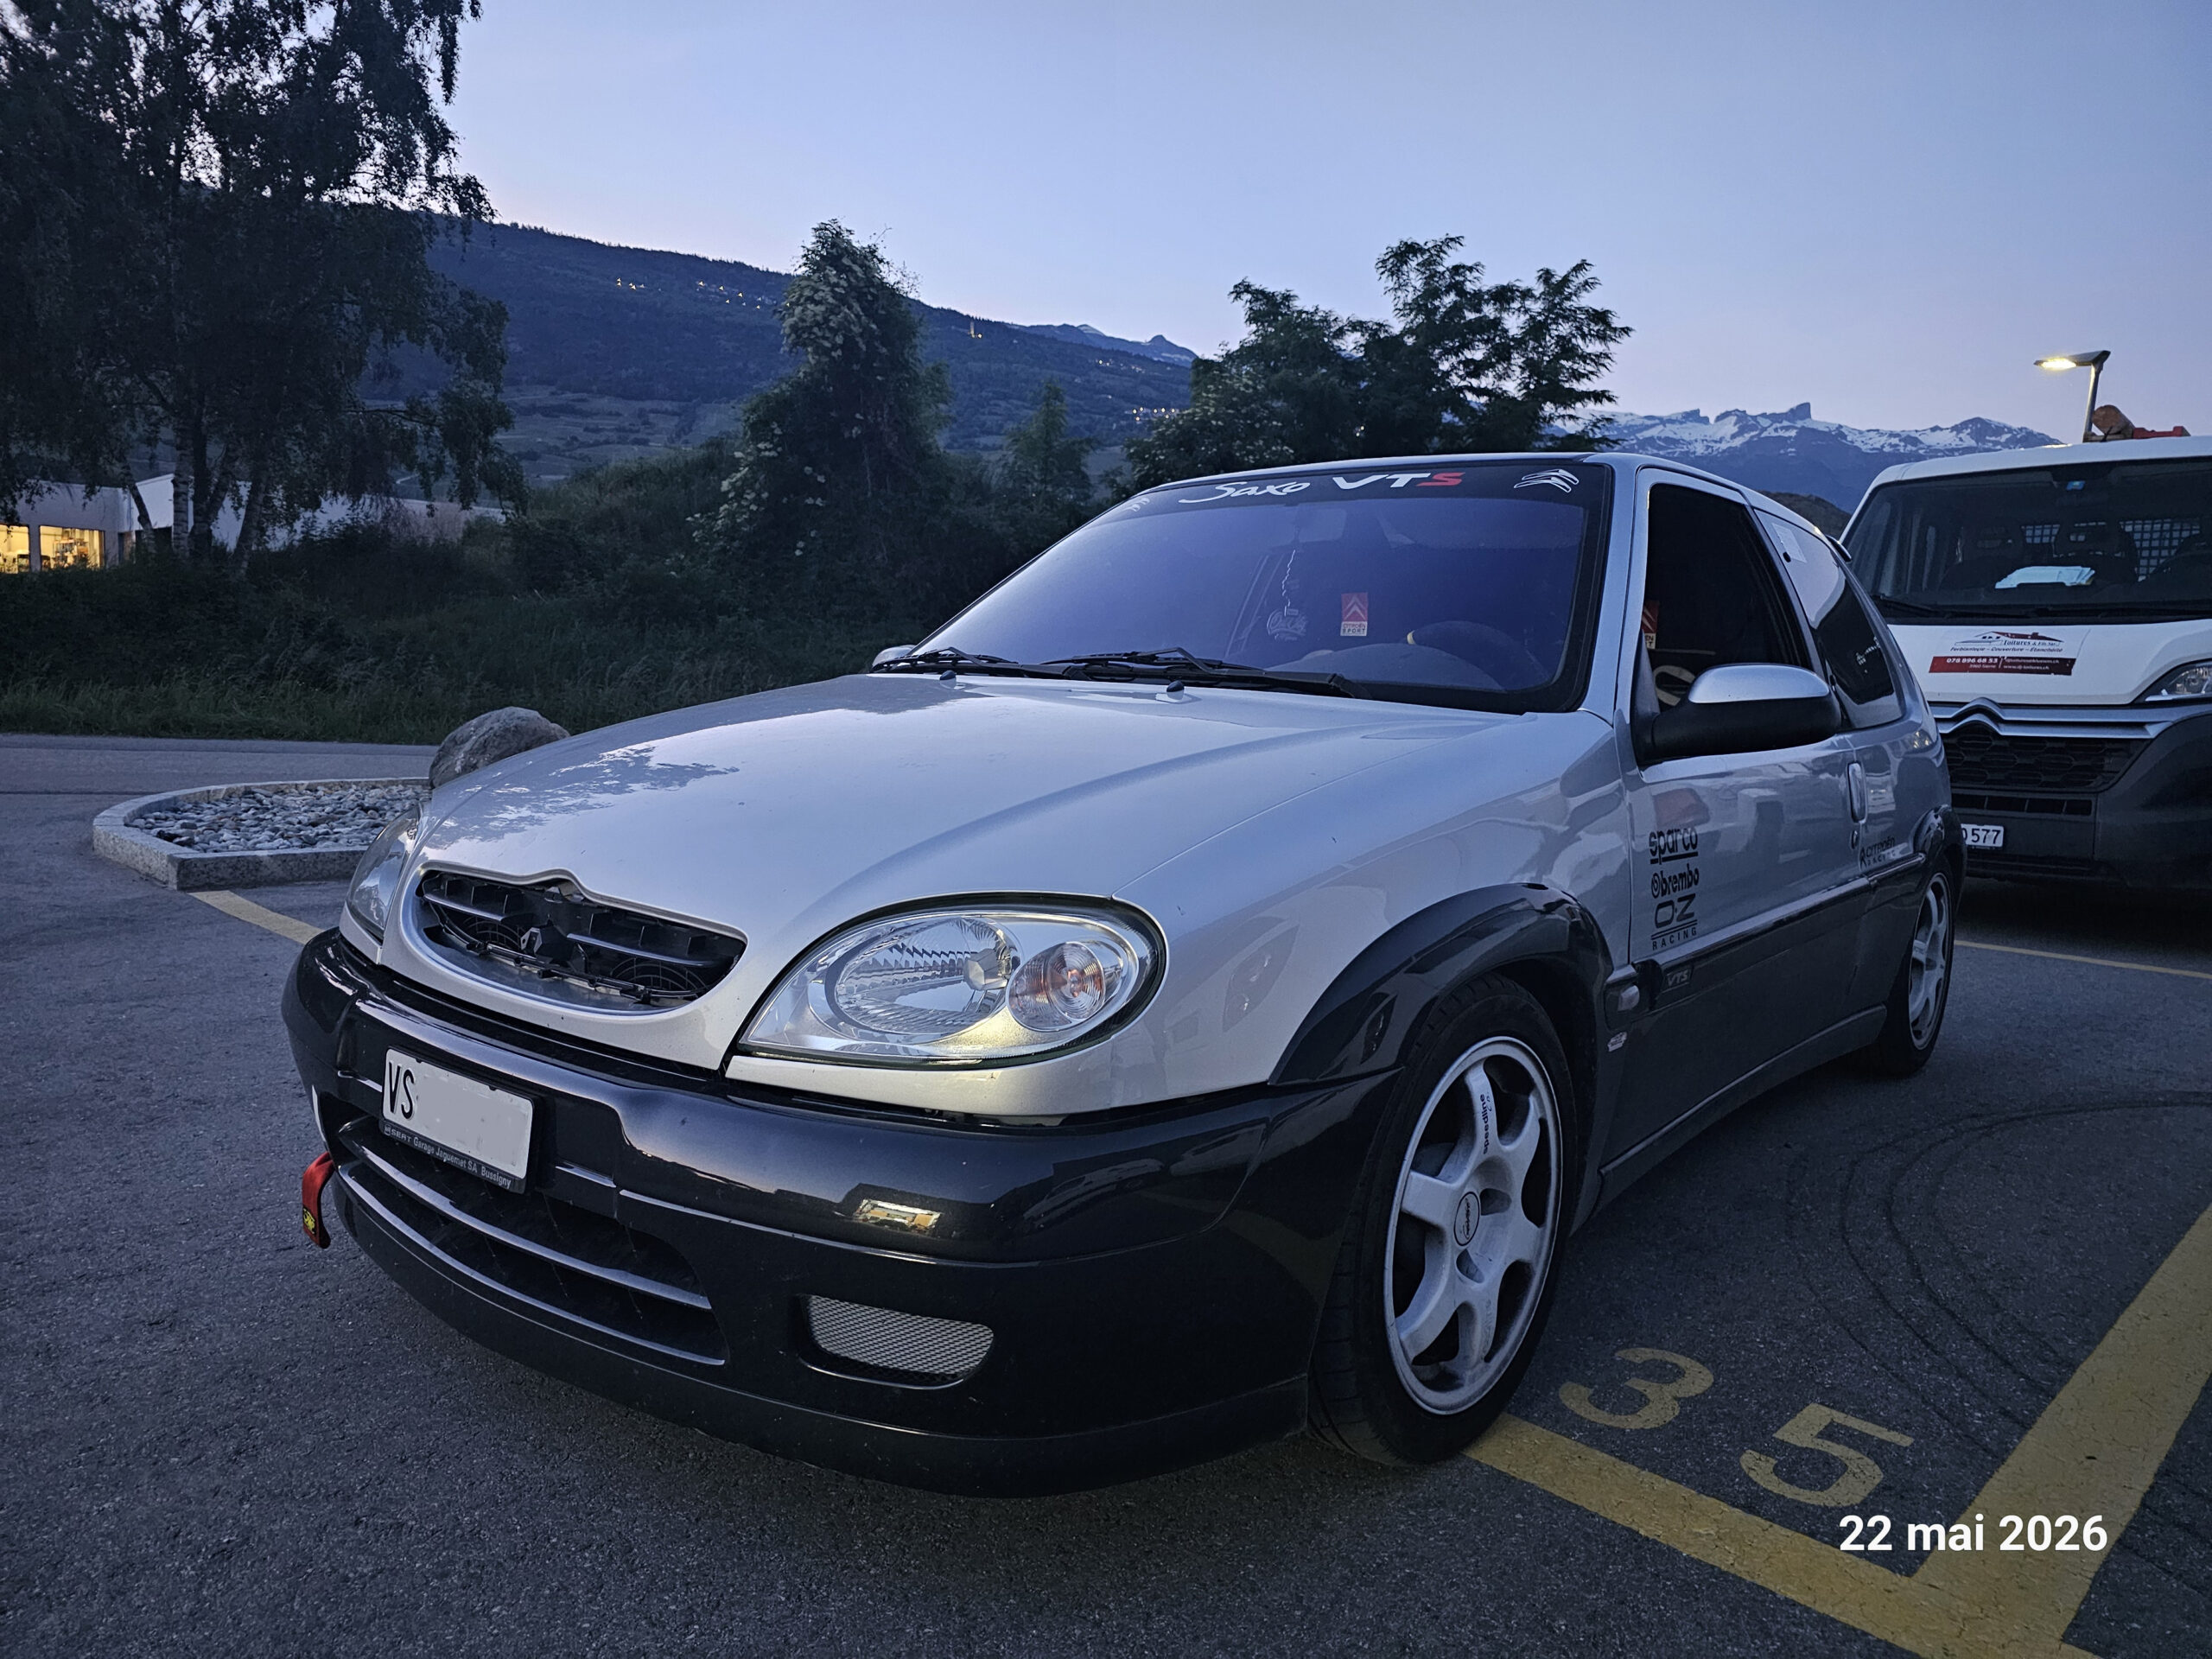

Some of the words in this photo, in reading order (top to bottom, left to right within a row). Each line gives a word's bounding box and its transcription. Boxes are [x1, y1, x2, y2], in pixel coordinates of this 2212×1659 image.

[1178, 481, 1311, 504] Saxo
[1332, 472, 1465, 490] VTS
[1649, 828, 1699, 864] sparco
[1660, 862, 1700, 898] brembo
[1652, 927, 1697, 950] RACING
[389, 1061, 415, 1120] VS
[1479, 1093, 1490, 1155] speedline
[391, 1128, 412, 1143] SEAT
[413, 1136, 435, 1155] Garage
[467, 1160, 478, 1173] SA
[480, 1166, 512, 1190] Bussigny
